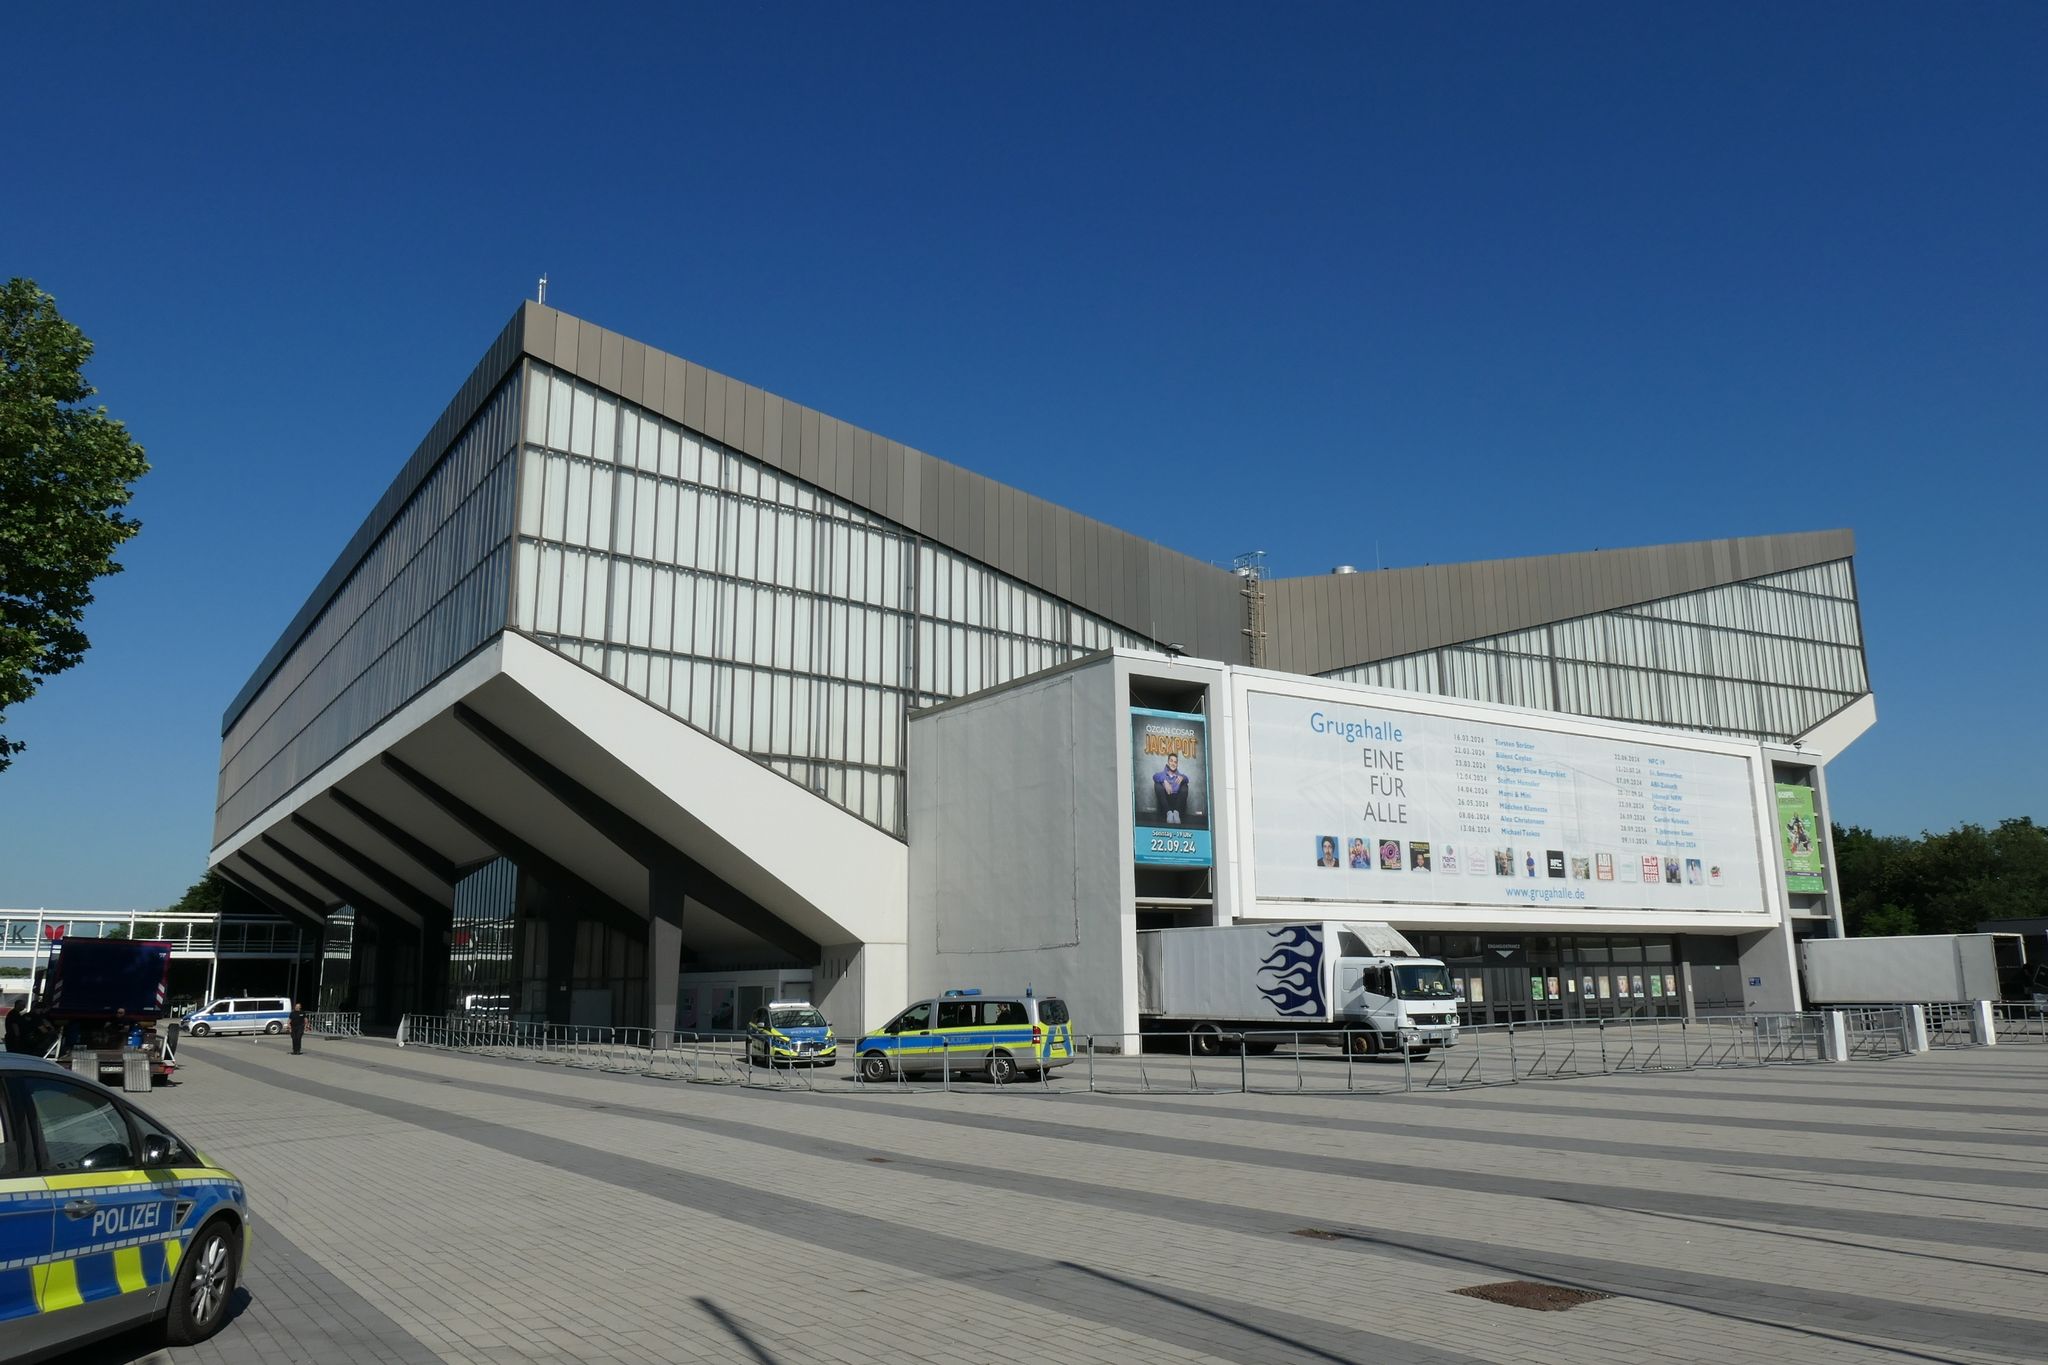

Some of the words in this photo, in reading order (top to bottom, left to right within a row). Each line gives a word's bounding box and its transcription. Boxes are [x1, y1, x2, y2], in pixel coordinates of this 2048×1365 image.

[1310, 712, 1402, 742] Grugahalle
[1454, 734, 1484, 743] 16.03.2024
[1145, 734, 1197, 759] JACKPOT
[1364, 748, 1404, 772] EINE
[1370, 773, 1406, 798] FÜR
[1364, 802, 1408, 824] ALLE
[1152, 839, 1196, 852] 22.09.24
[1505, 888, 1585, 901] www.grugahalle.de
[92, 1202, 161, 1236] POLIZEI
